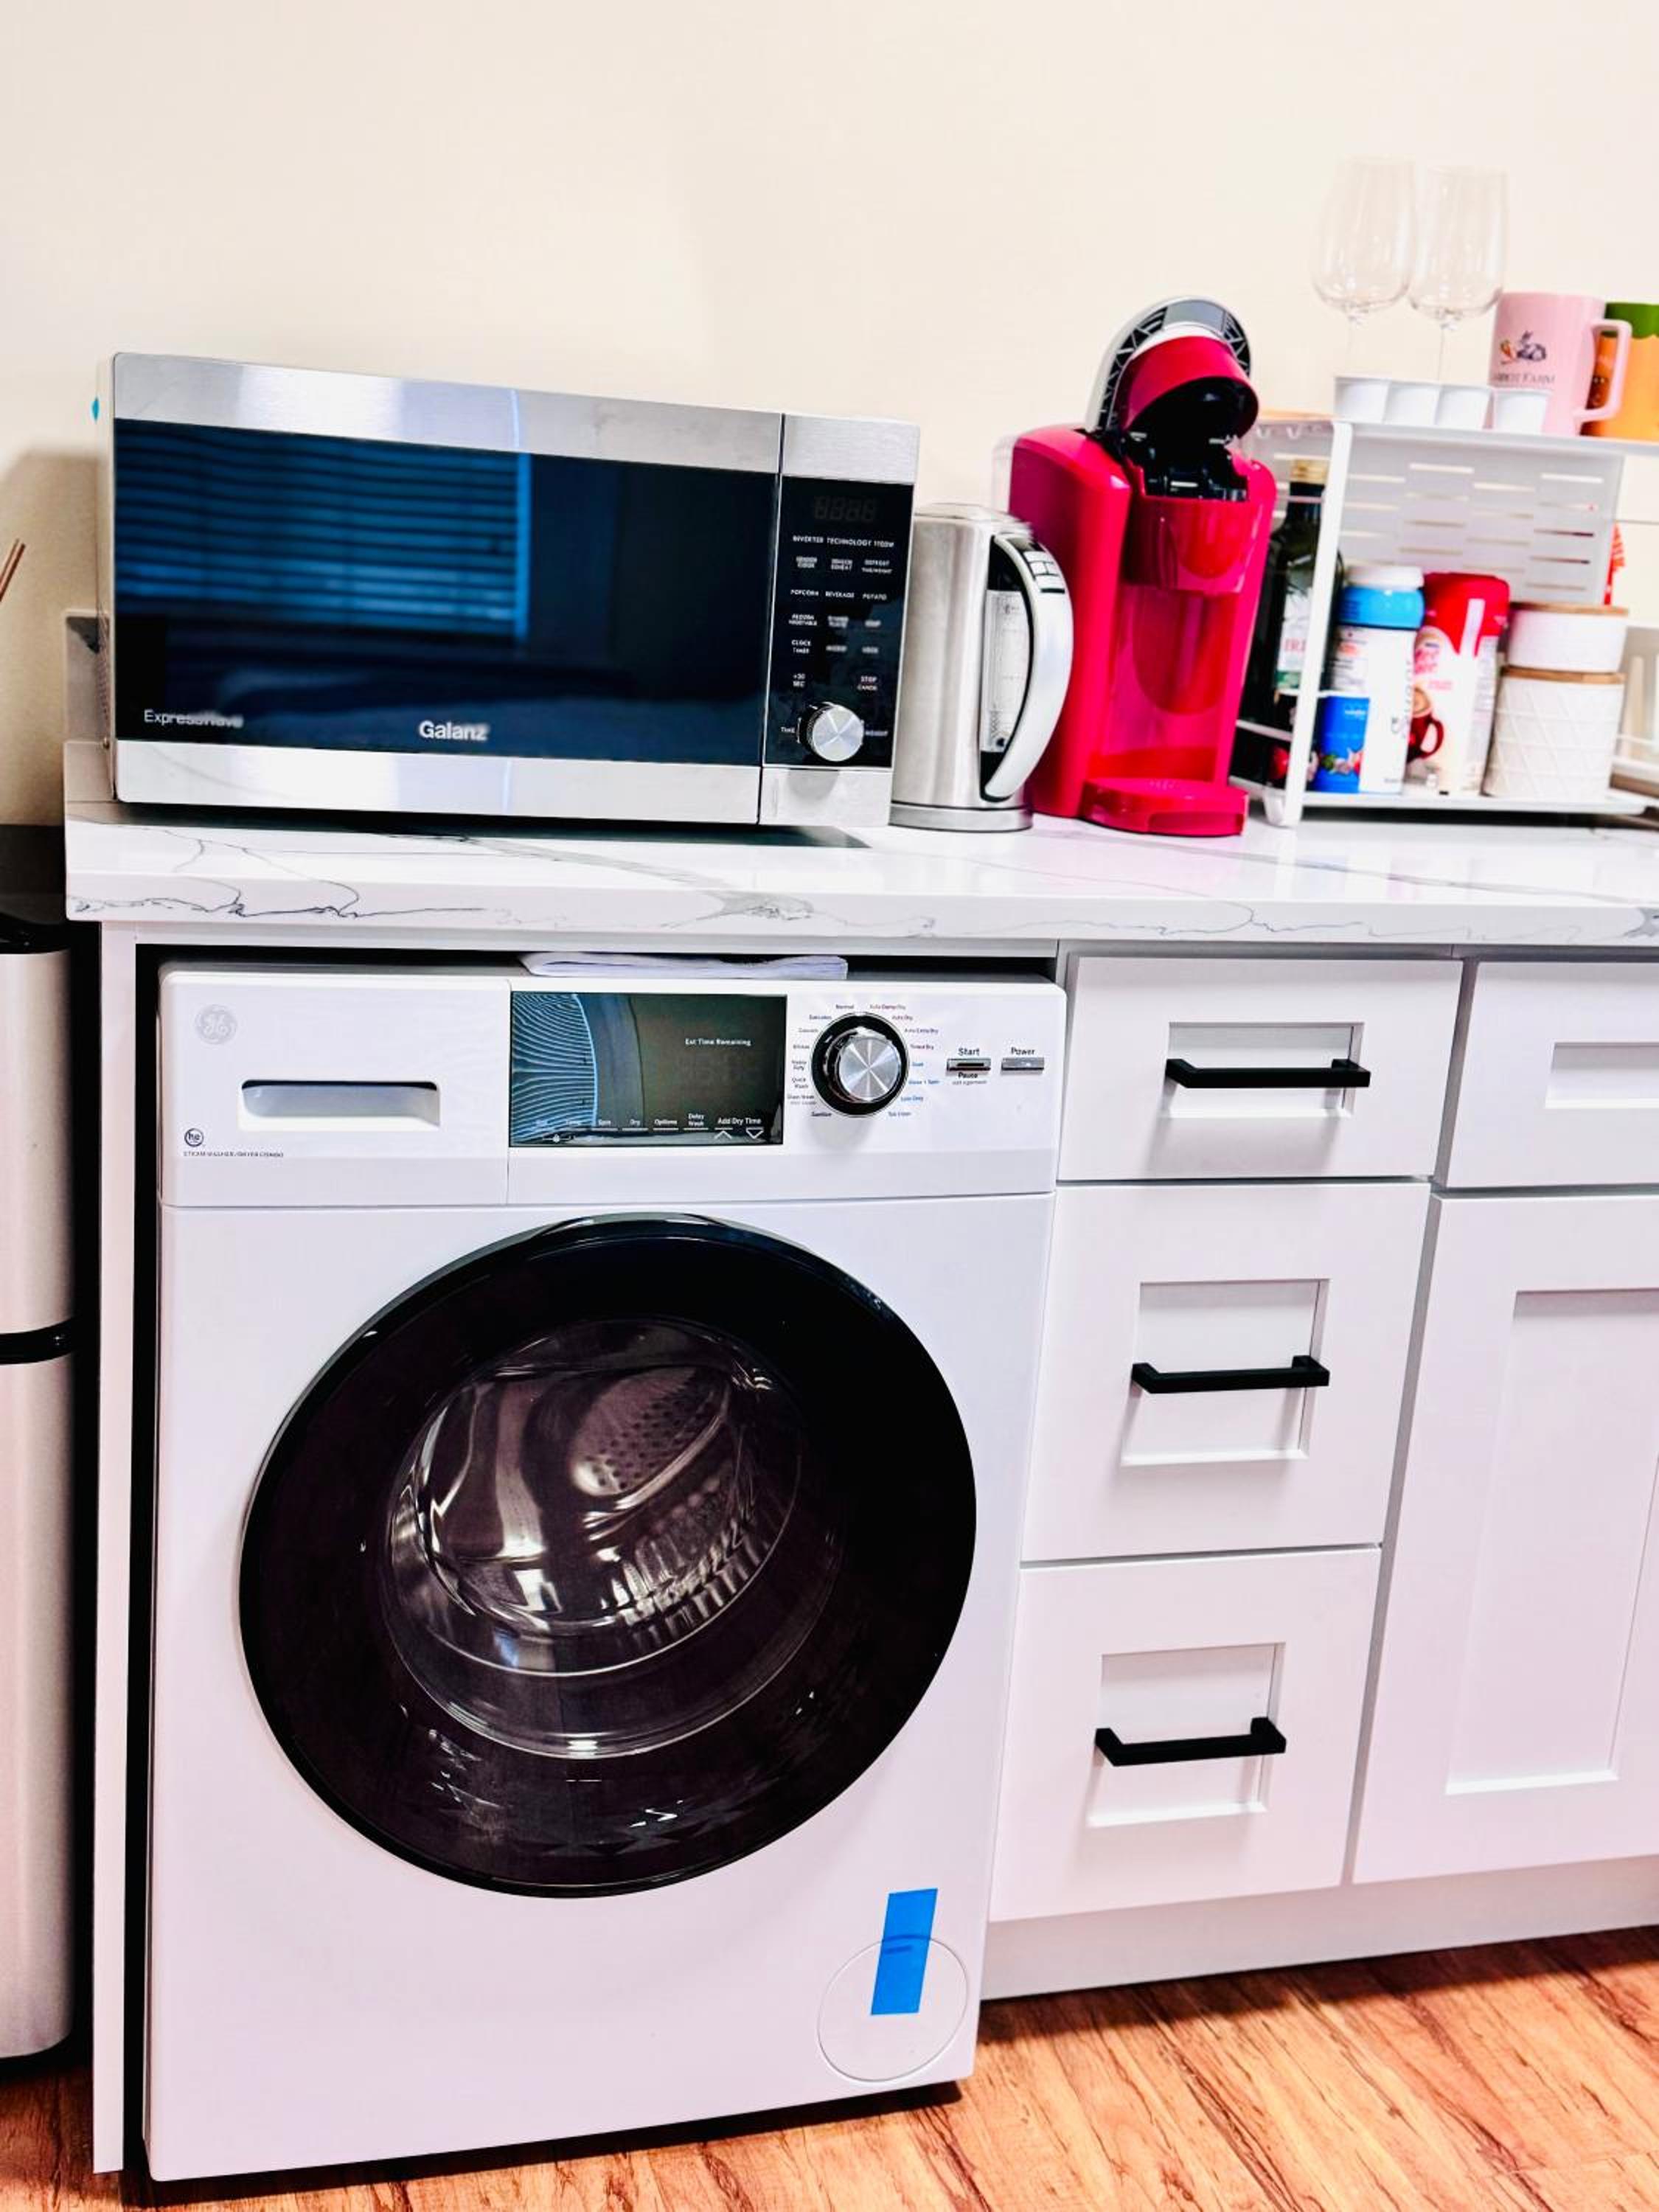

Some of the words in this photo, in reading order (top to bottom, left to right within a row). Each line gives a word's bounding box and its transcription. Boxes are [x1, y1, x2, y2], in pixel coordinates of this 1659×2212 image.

[827, 537, 872, 547] TECHNOLOGY
[419, 720, 491, 742] Galanz
[716, 1038, 751, 1047] Remaining
[959, 1048, 980, 1056] Start
[1011, 1047, 1035, 1055] Power
[630, 1119, 641, 1127] Dry
[655, 1119, 678, 1127] Options
[731, 1117, 744, 1126] Dry
